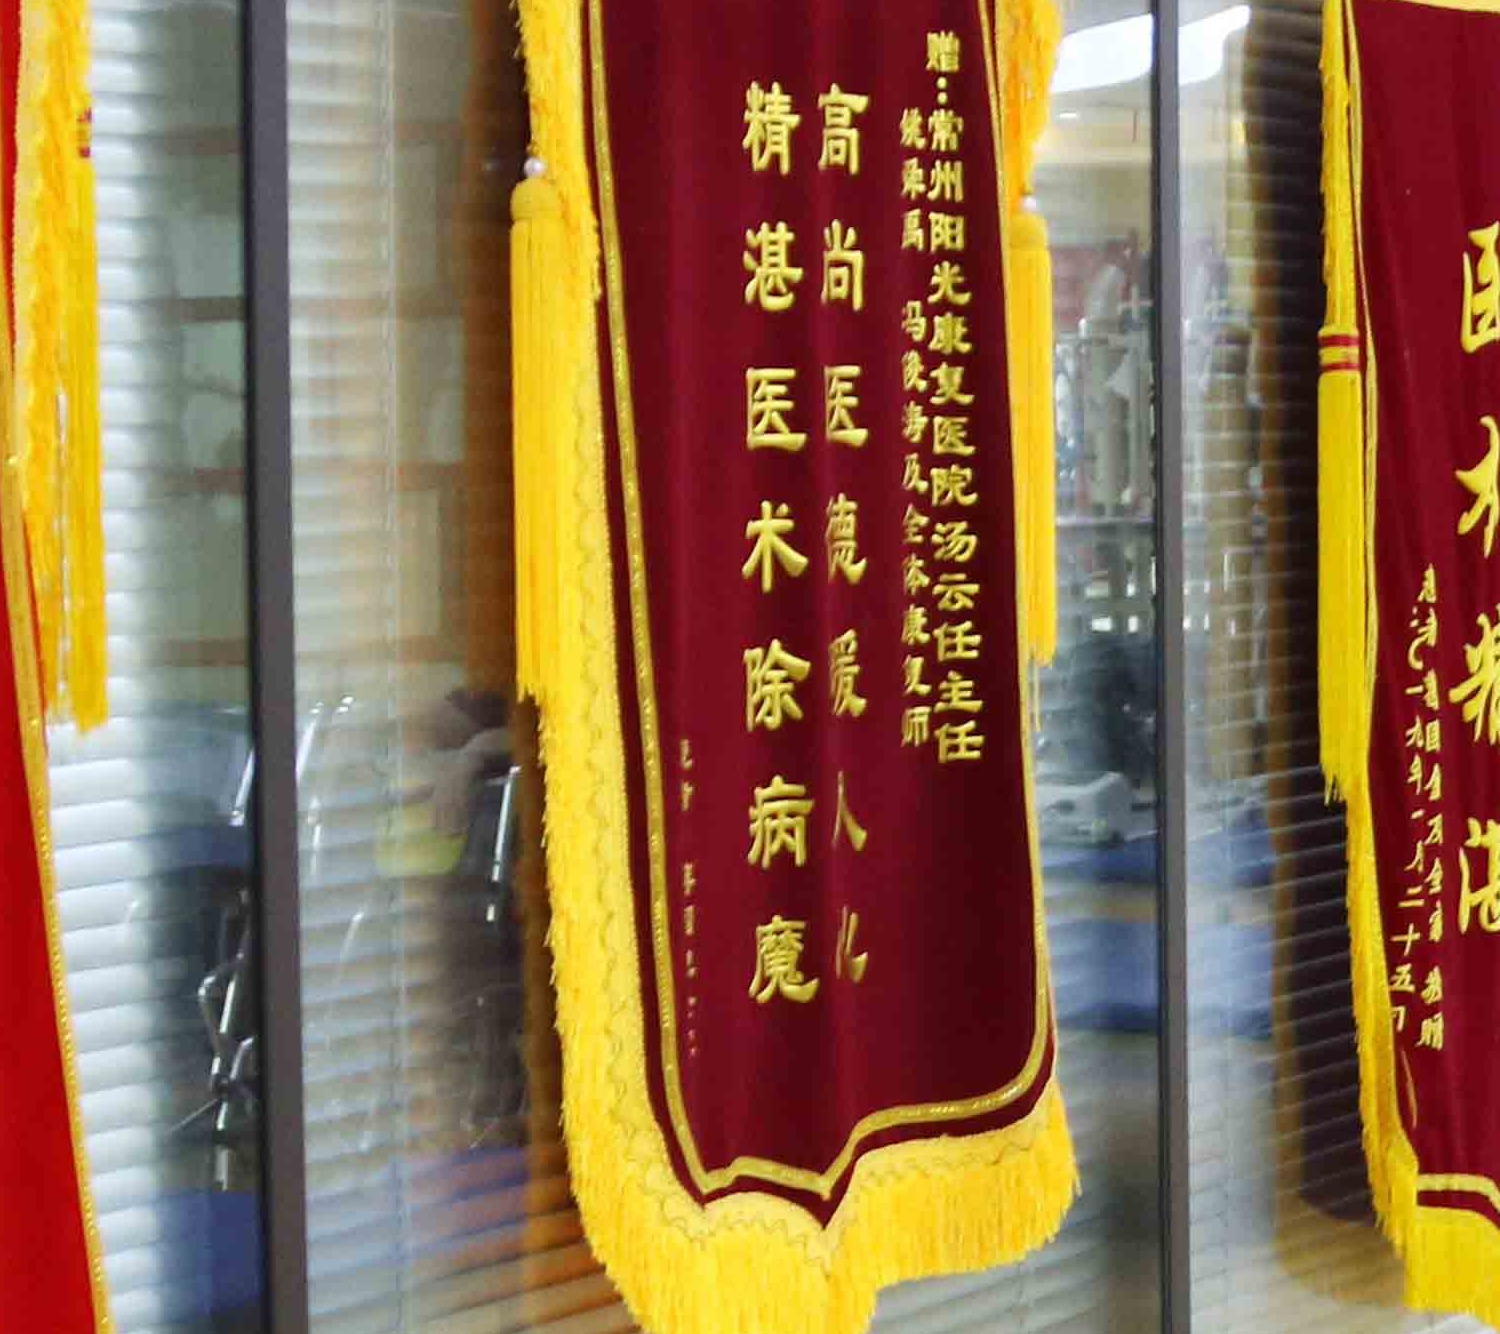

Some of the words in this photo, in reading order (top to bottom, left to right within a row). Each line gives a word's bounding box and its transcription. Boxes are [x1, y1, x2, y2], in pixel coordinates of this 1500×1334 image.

[742, 82, 818, 1003] 精湛医术除病魔
[819, 83, 868, 979] 高尚医德暖人心
[927, 31, 984, 761] 赠：常州阳光康复医院汤云任主任
